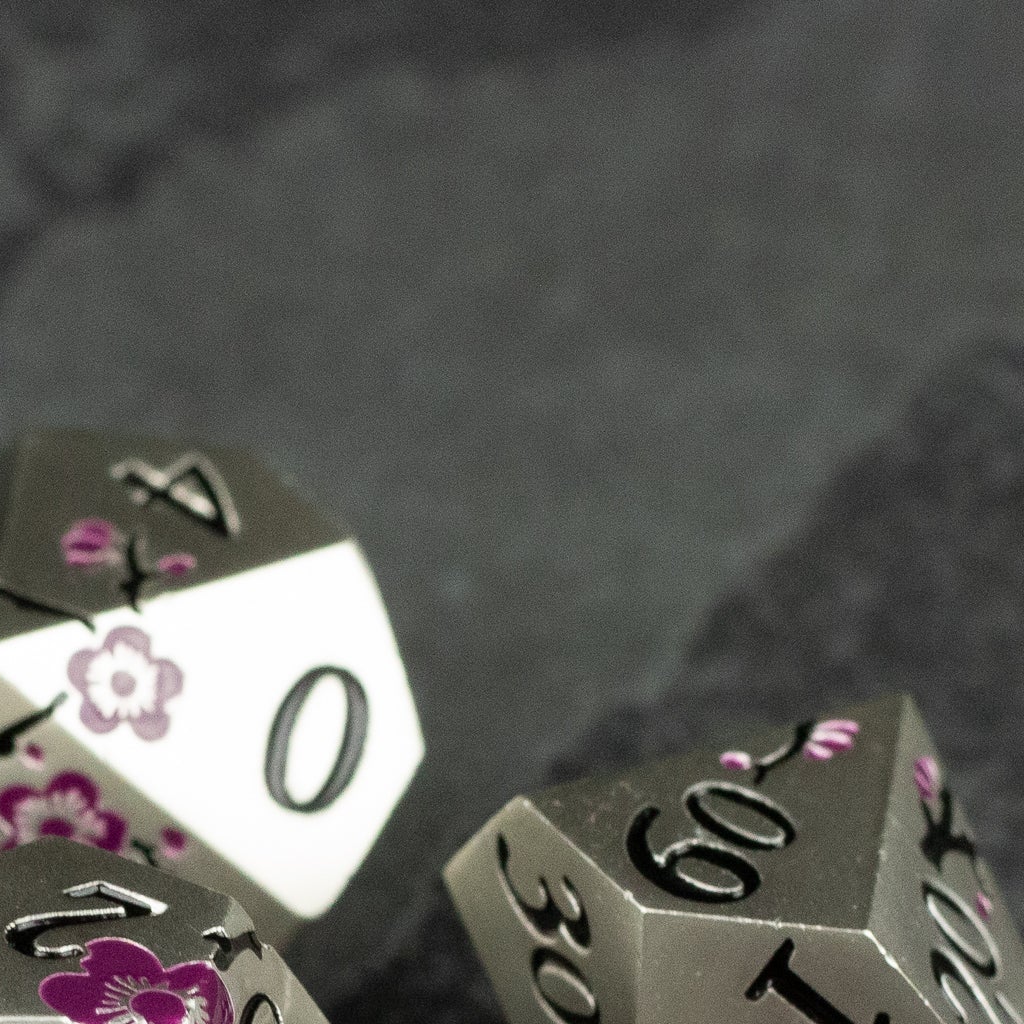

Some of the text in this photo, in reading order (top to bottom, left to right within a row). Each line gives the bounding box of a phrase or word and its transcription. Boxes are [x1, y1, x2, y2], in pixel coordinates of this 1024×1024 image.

[112, 453, 240, 538] 4
[264, 664, 370, 814] 0
[625, 781, 797, 903] 60
